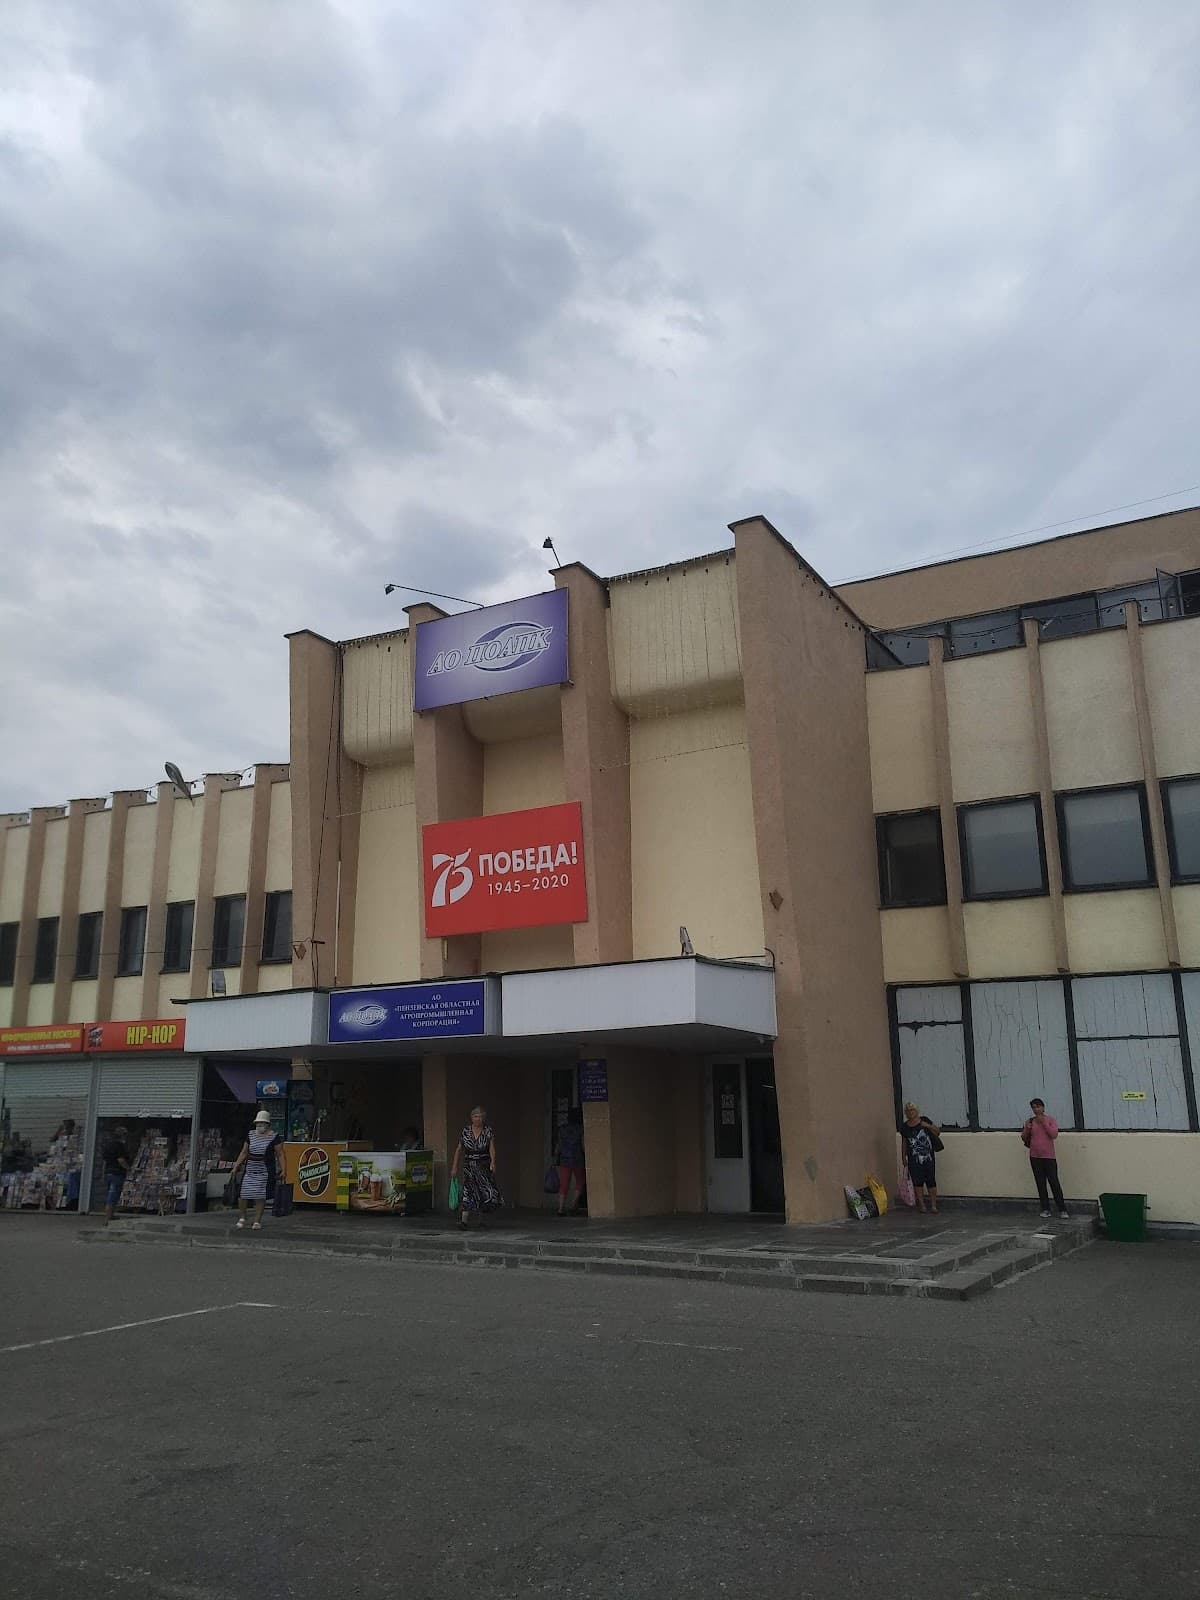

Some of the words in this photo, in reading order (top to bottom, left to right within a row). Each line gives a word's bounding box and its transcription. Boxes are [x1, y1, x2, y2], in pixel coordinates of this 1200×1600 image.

[427, 649, 461, 676] АО
[464, 627, 552, 665] ПОАПК
[479, 841, 578, 877] ПОБЕДА!
[432, 848, 473, 907] 75
[400, 1009, 474, 1020] АГРОПРОМЫШЛЕННАЯ
[439, 1000, 480, 1009] ОБЛАСТНАЯ
[127, 1025, 176, 1045] HIP-HOP
